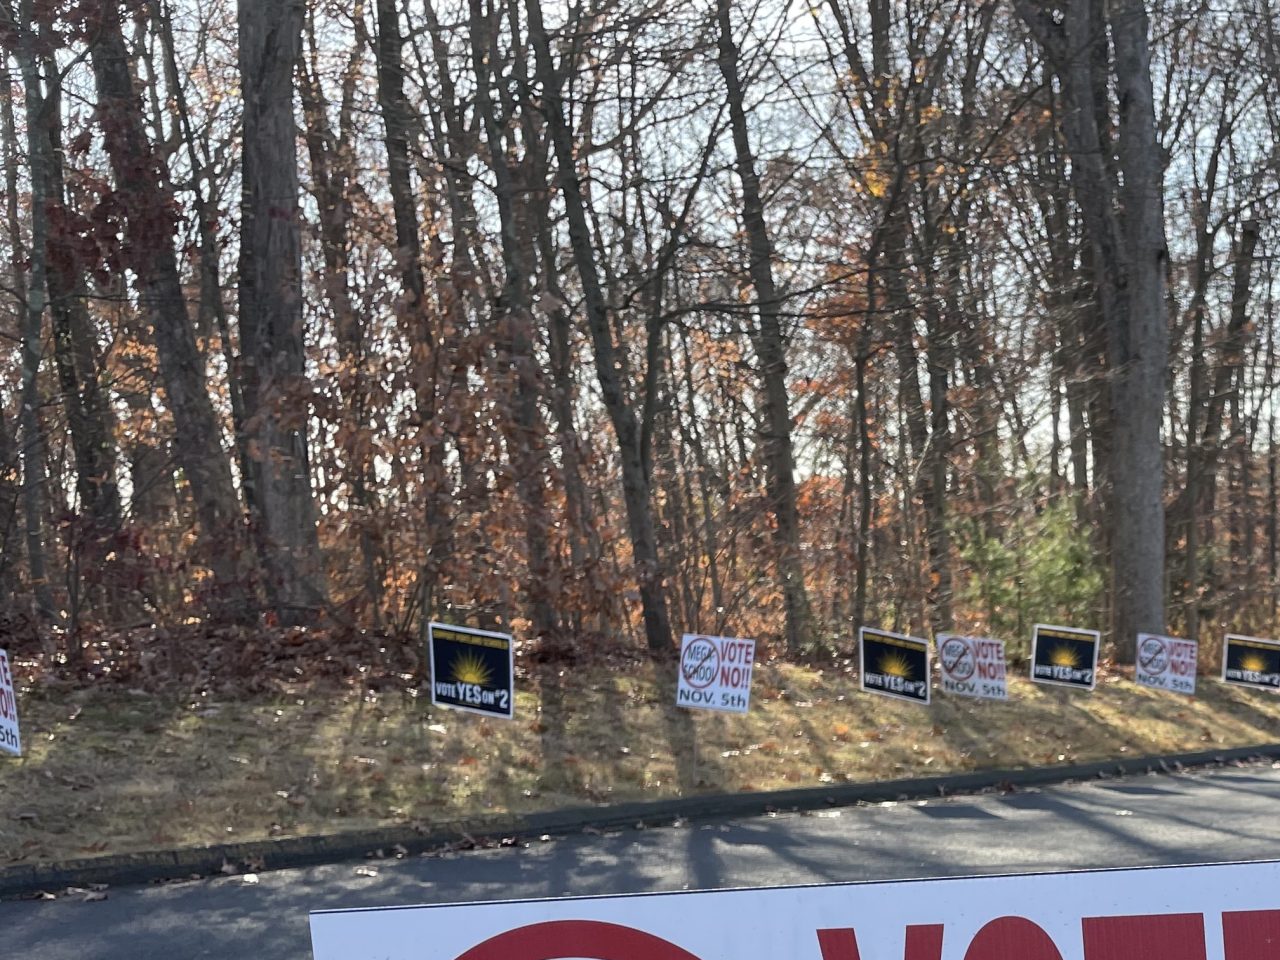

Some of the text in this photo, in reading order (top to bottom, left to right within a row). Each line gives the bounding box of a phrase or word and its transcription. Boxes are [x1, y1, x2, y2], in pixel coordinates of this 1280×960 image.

[721, 641, 753, 664] VOTE
[974, 641, 1003, 660] VOTE
[720, 667, 750, 690] NO!!
[884, 672, 904, 691] YES
[436, 682, 456, 698] VOTE
[457, 682, 482, 704] YES
[680, 689, 746, 708] NOV. 5th
